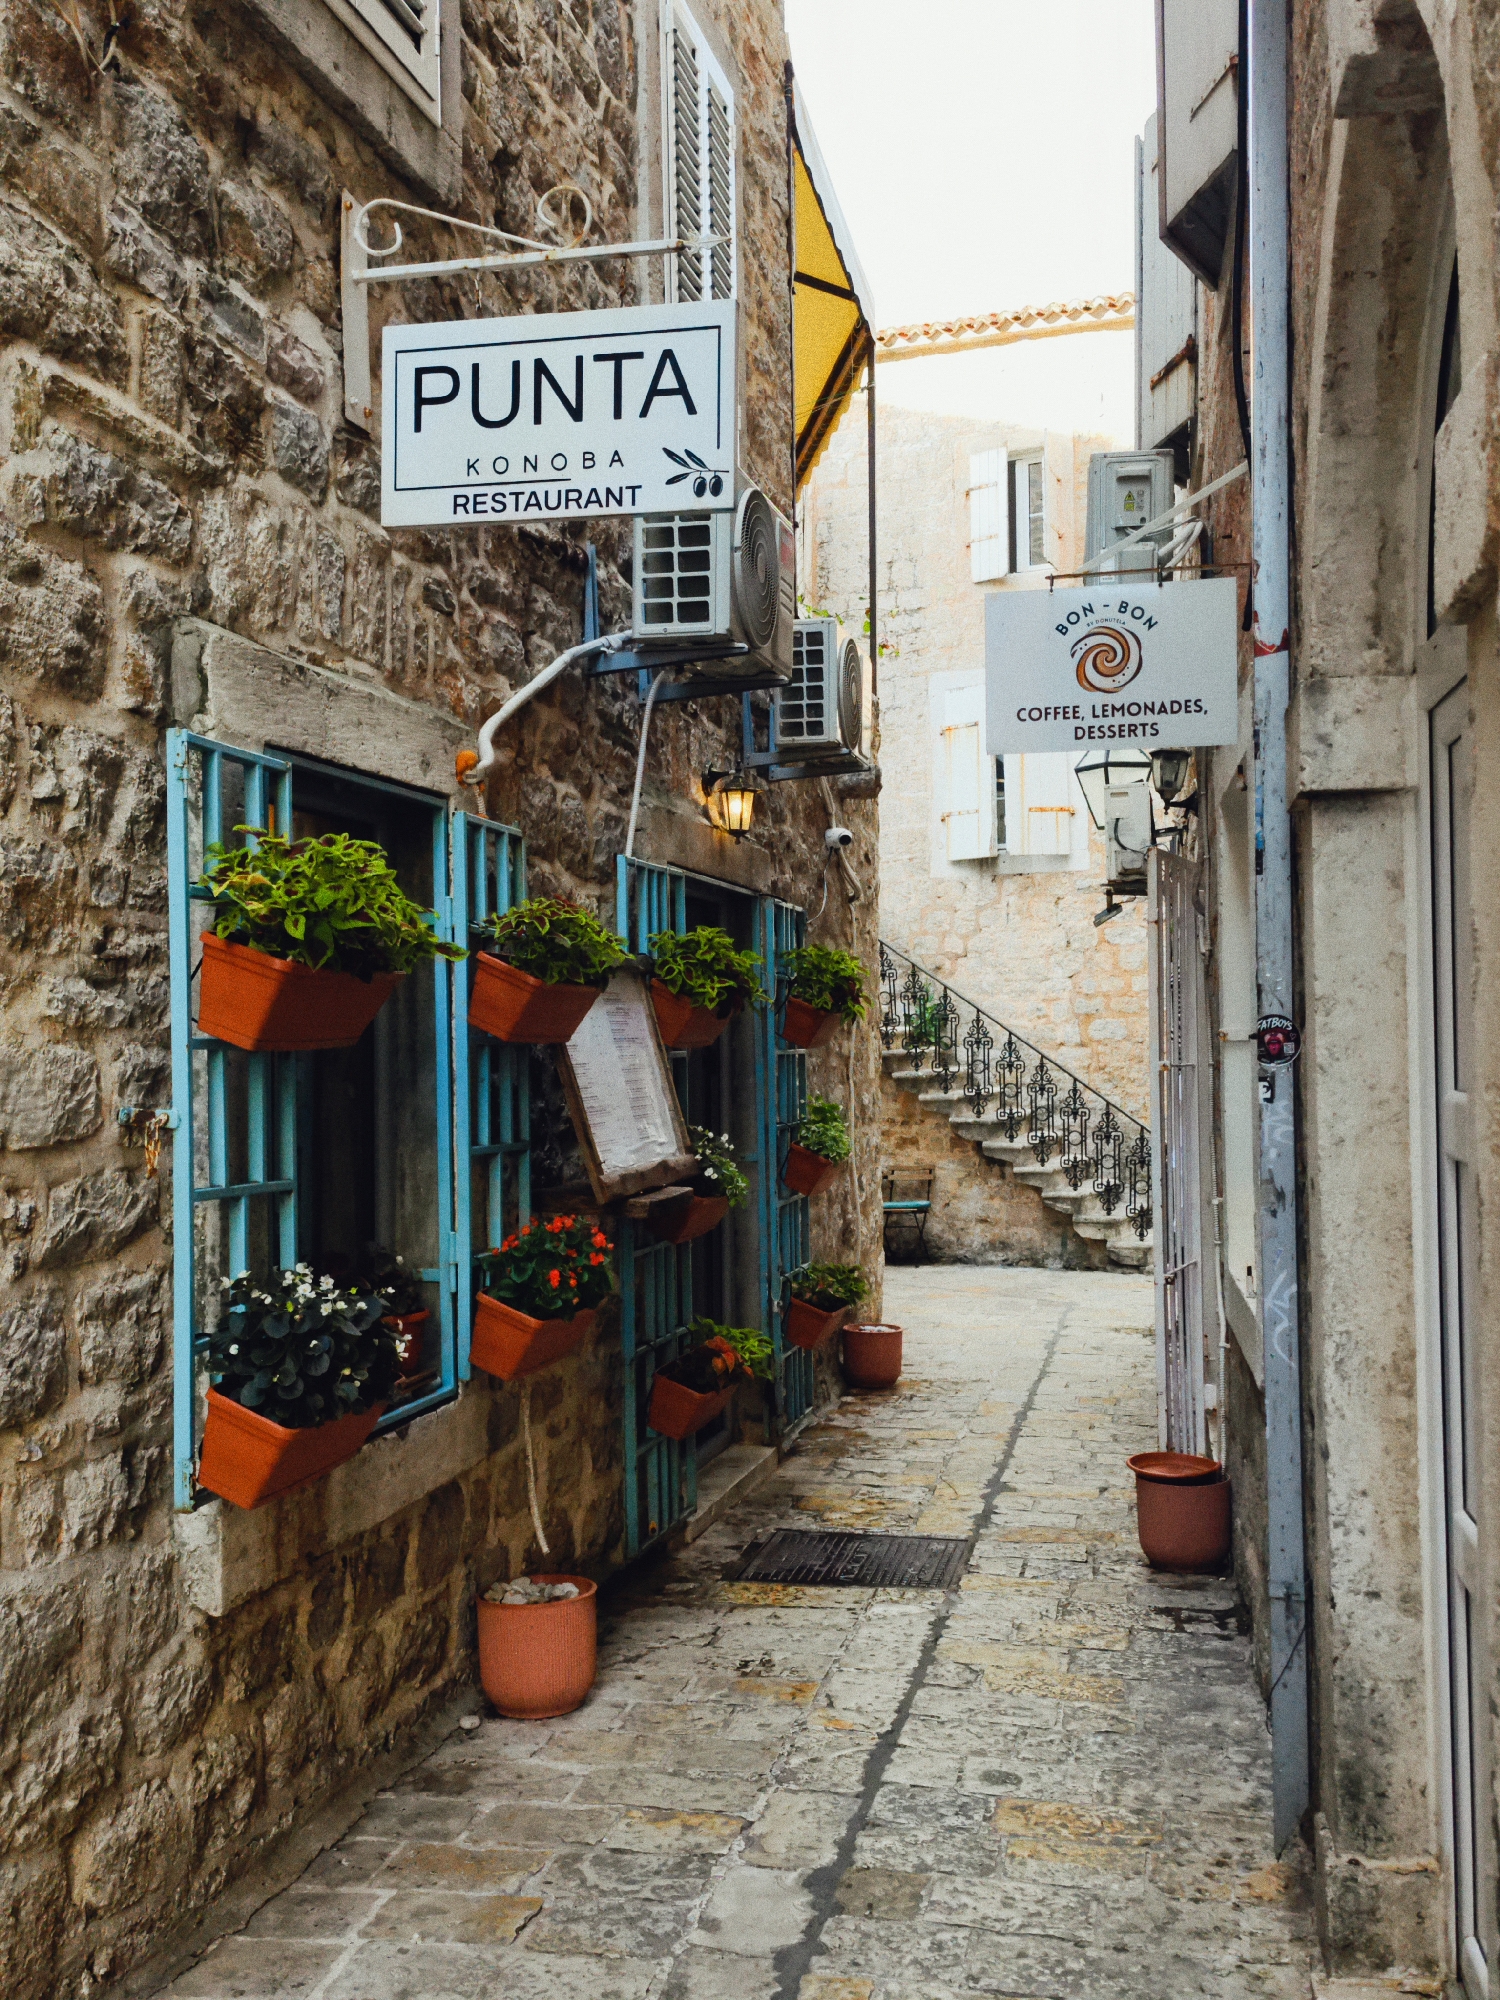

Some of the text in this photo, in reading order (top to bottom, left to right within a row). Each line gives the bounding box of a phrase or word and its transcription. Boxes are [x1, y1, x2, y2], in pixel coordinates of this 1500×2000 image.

[414, 348, 698, 434] PUNTA
[466, 450, 625, 477] KONOBA
[453, 485, 643, 515] RESTAURANT
[1016, 698, 1208, 722] COFFEE, LEMONADES,
[1074, 722, 1160, 740] DESSERTS
